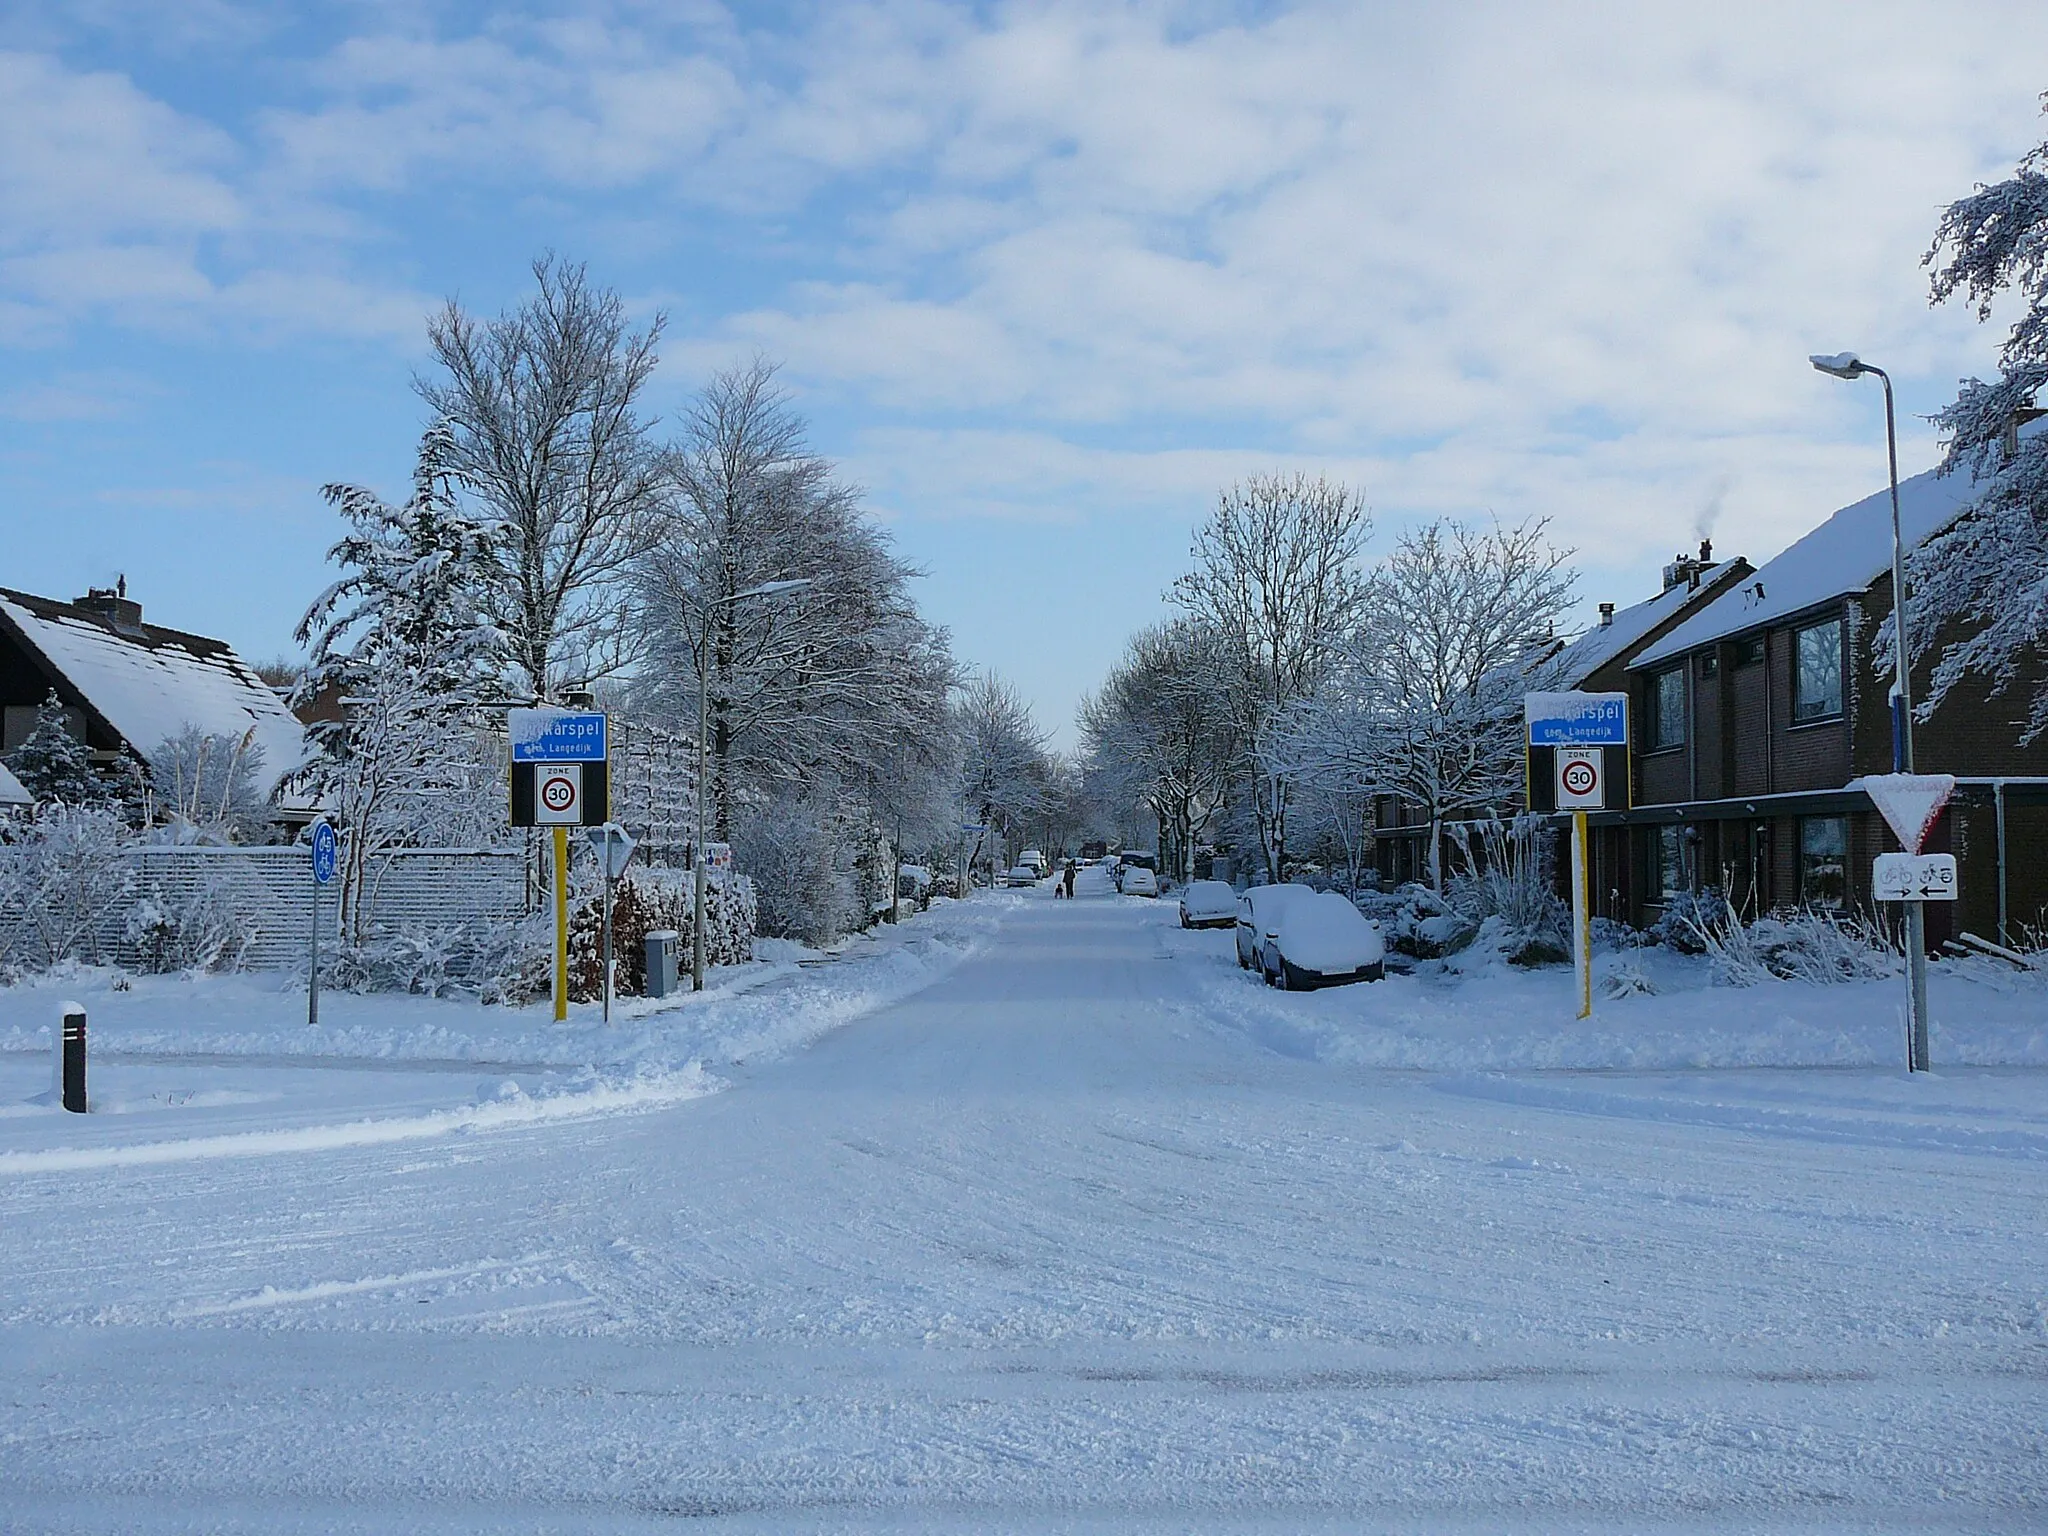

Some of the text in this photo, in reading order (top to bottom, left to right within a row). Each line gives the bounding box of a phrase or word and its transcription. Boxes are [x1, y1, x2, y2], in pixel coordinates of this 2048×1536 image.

[1544, 727, 1612, 738] gem Langedijk
[549, 743, 592, 754] Langedijk
[547, 767, 570, 775] ZONE
[1569, 771, 1591, 785] 30
[548, 787, 569, 801] 30
